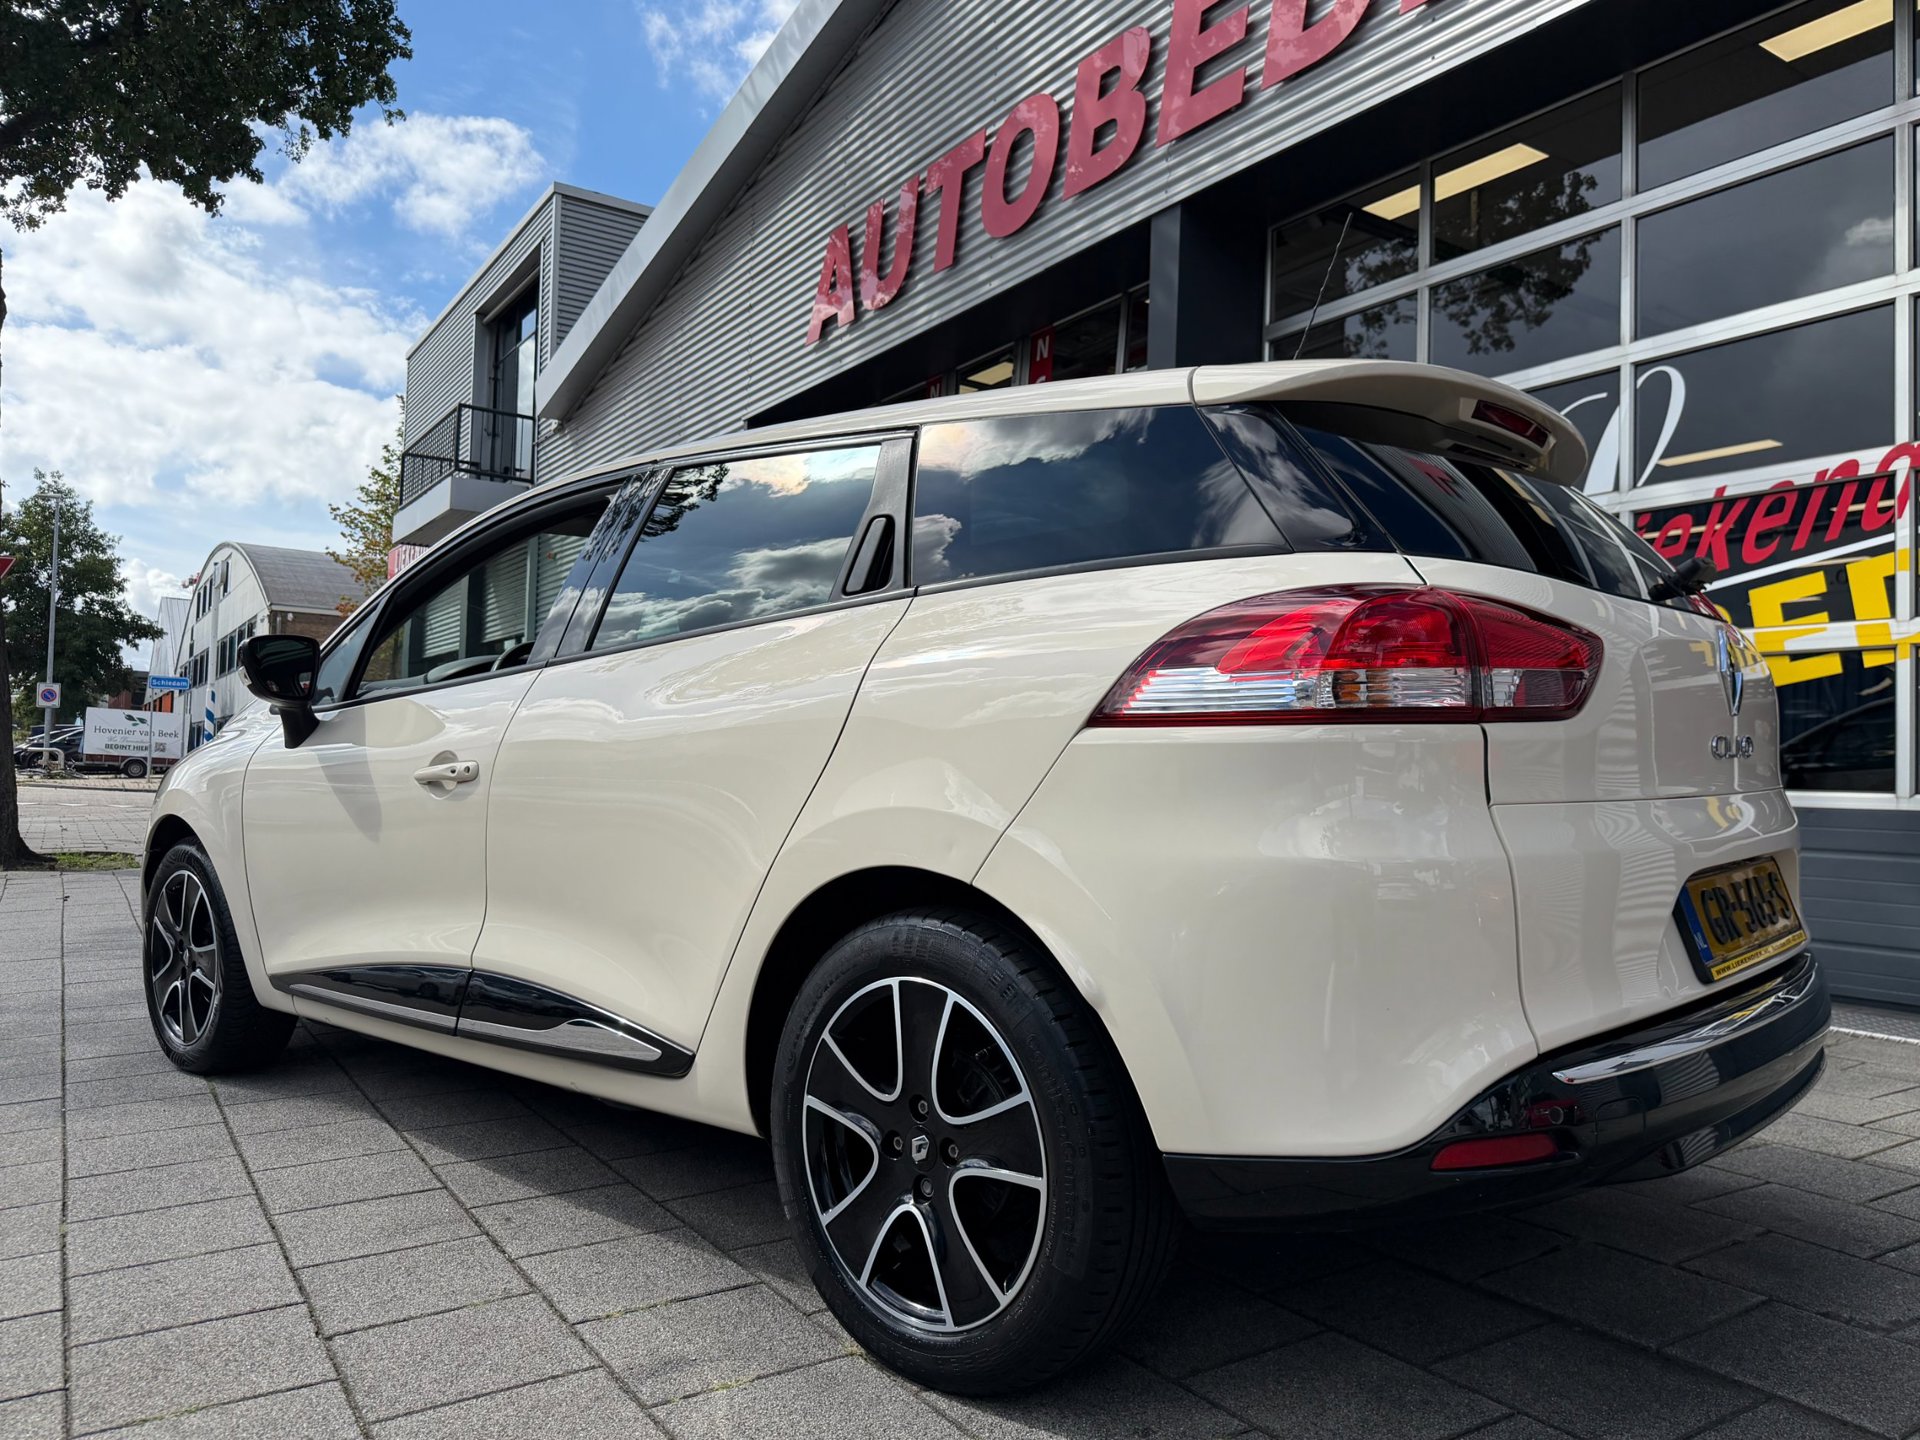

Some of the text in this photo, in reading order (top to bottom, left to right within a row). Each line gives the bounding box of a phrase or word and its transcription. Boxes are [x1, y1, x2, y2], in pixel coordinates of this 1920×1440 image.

[805, 0, 1427, 346] AUTOBE
[152, 679, 188, 687] Schiedam
[94, 725, 136, 736] Hovenier
[158, 730, 179, 738] Beek
[1711, 735, 1754, 760] CLIO
